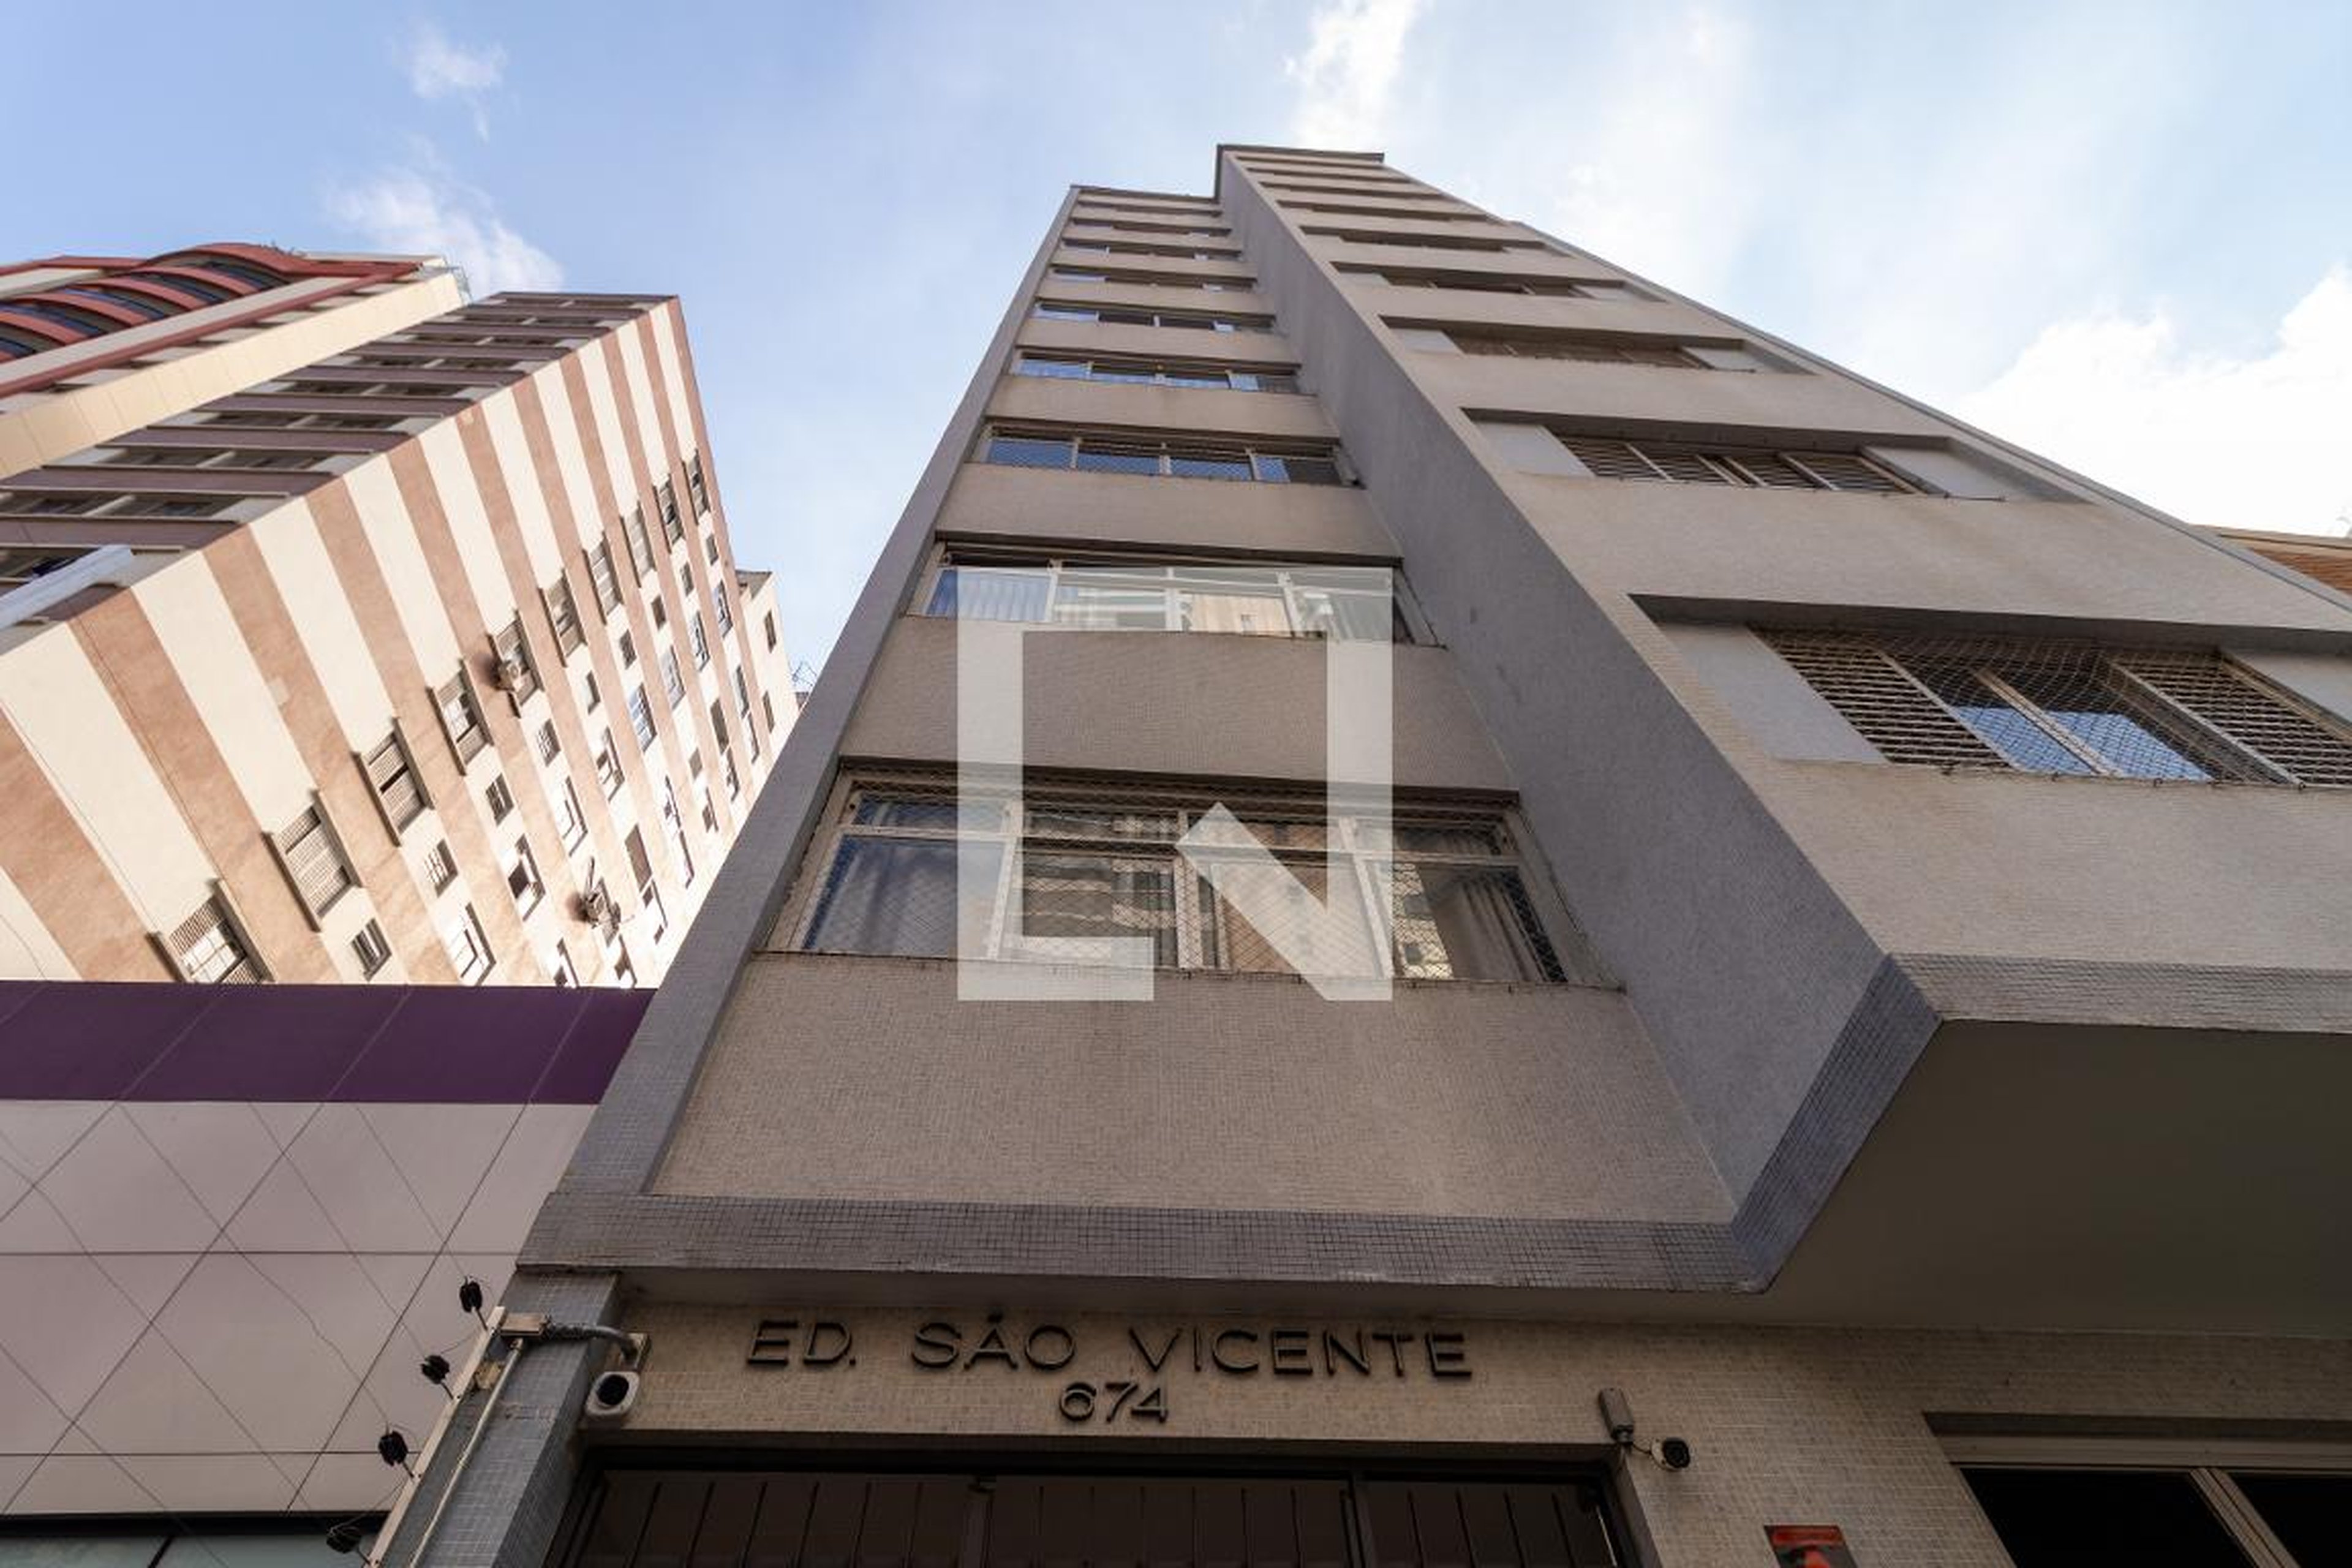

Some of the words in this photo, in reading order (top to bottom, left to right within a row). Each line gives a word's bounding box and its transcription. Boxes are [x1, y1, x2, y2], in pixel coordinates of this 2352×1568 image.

[747, 1320, 857, 1368] ED.
[1129, 1326, 1472, 1377] VICENTE
[1059, 1381, 1169, 1423] 674
